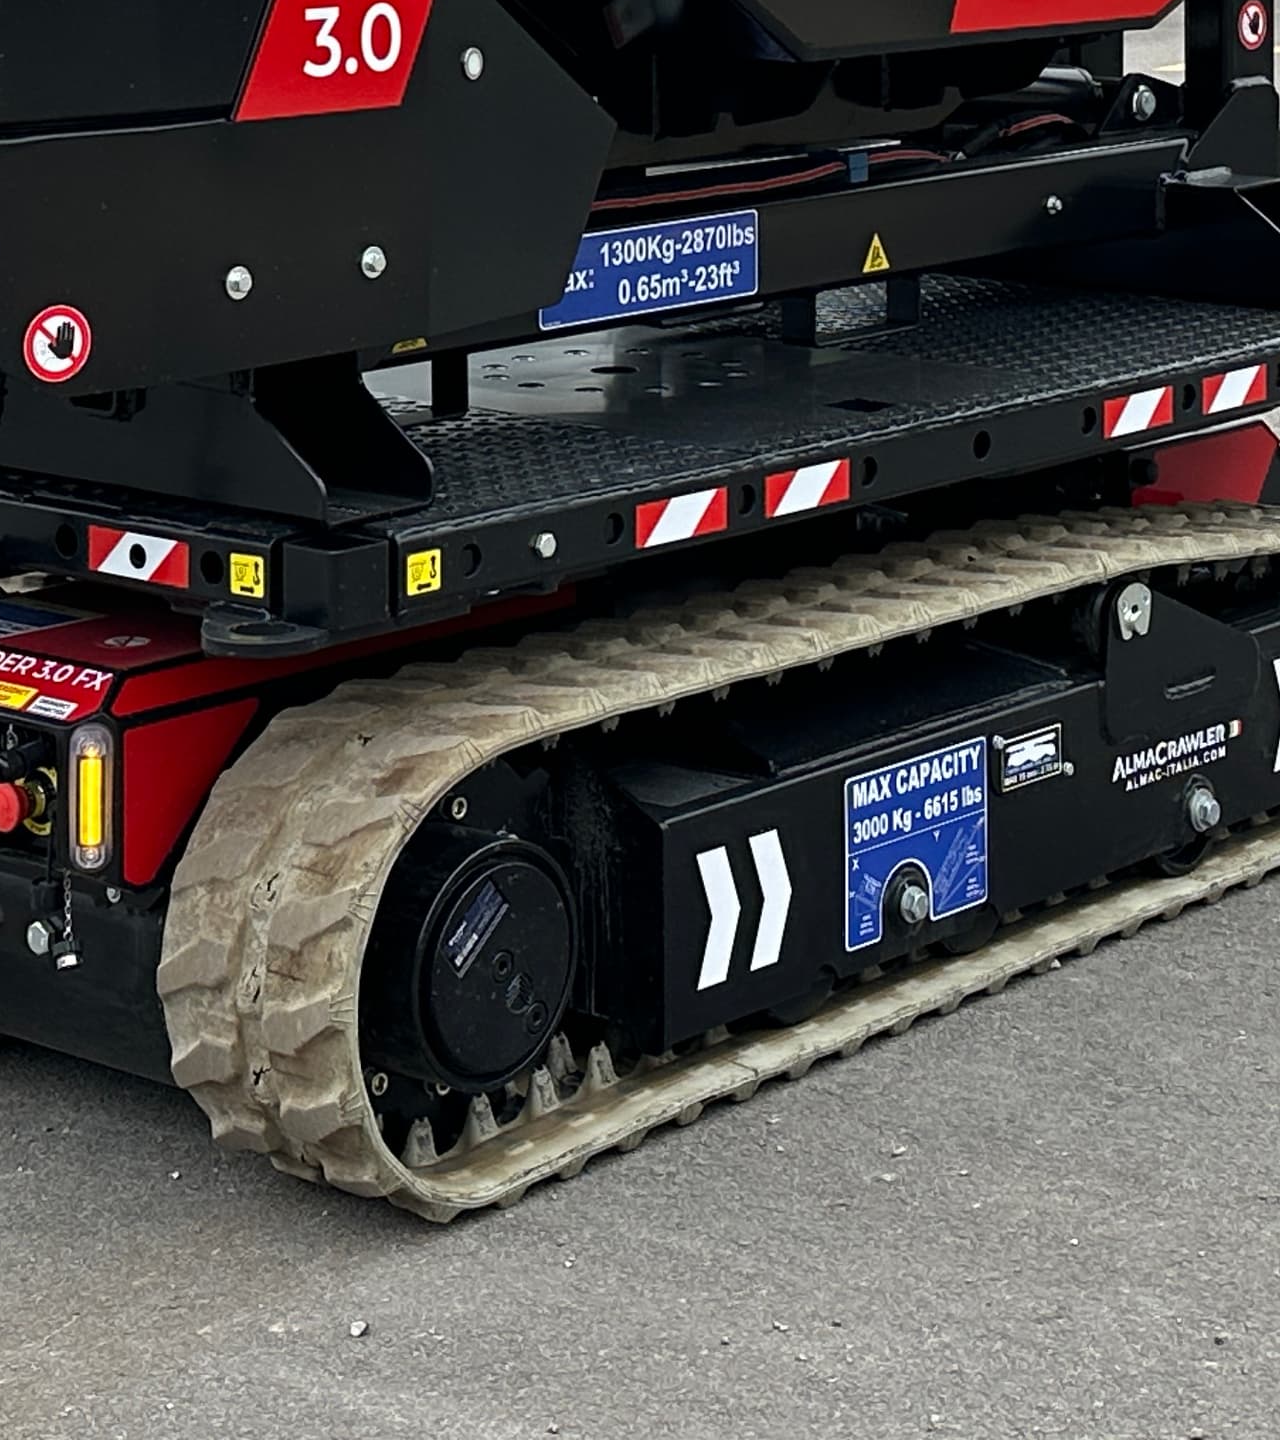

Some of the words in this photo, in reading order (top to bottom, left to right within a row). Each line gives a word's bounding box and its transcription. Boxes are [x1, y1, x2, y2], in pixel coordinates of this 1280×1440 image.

[302, 2, 402, 78] 3.0
[599, 222, 755, 268] 1300Kg-2870lbs
[564, 268, 595, 294] ax:
[32, 660, 75, 684] 3.0
[72, 668, 114, 691] FX
[852, 773, 892, 809] MAX
[895, 745, 981, 795] CAPACITY
[1124, 745, 1227, 792] ALMAC-ITALIA.COM
[852, 812, 888, 845] 3000
[892, 806, 913, 833] Kg
[923, 790, 958, 820] 6615
[961, 784, 983, 807] lbs
[851, 857, 860, 871] X
